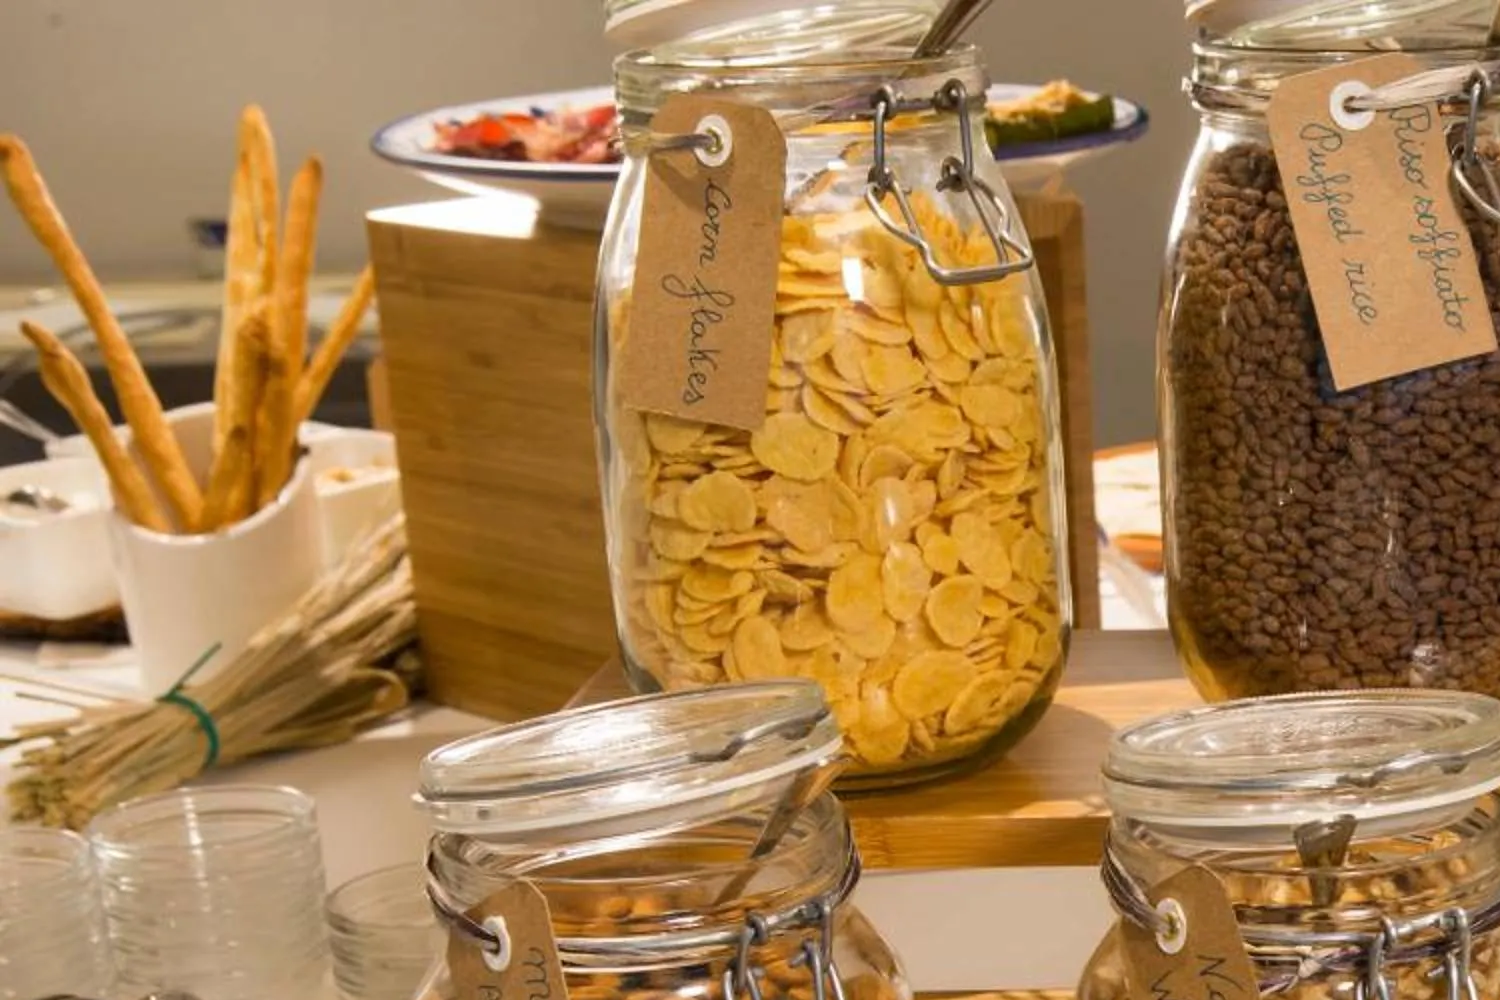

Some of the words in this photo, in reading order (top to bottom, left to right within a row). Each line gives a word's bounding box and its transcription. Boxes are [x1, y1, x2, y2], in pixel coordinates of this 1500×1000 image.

[1296, 122, 1364, 243] Puffed
[1341, 258, 1378, 326] rice
[1408, 195, 1471, 336] soffiato
